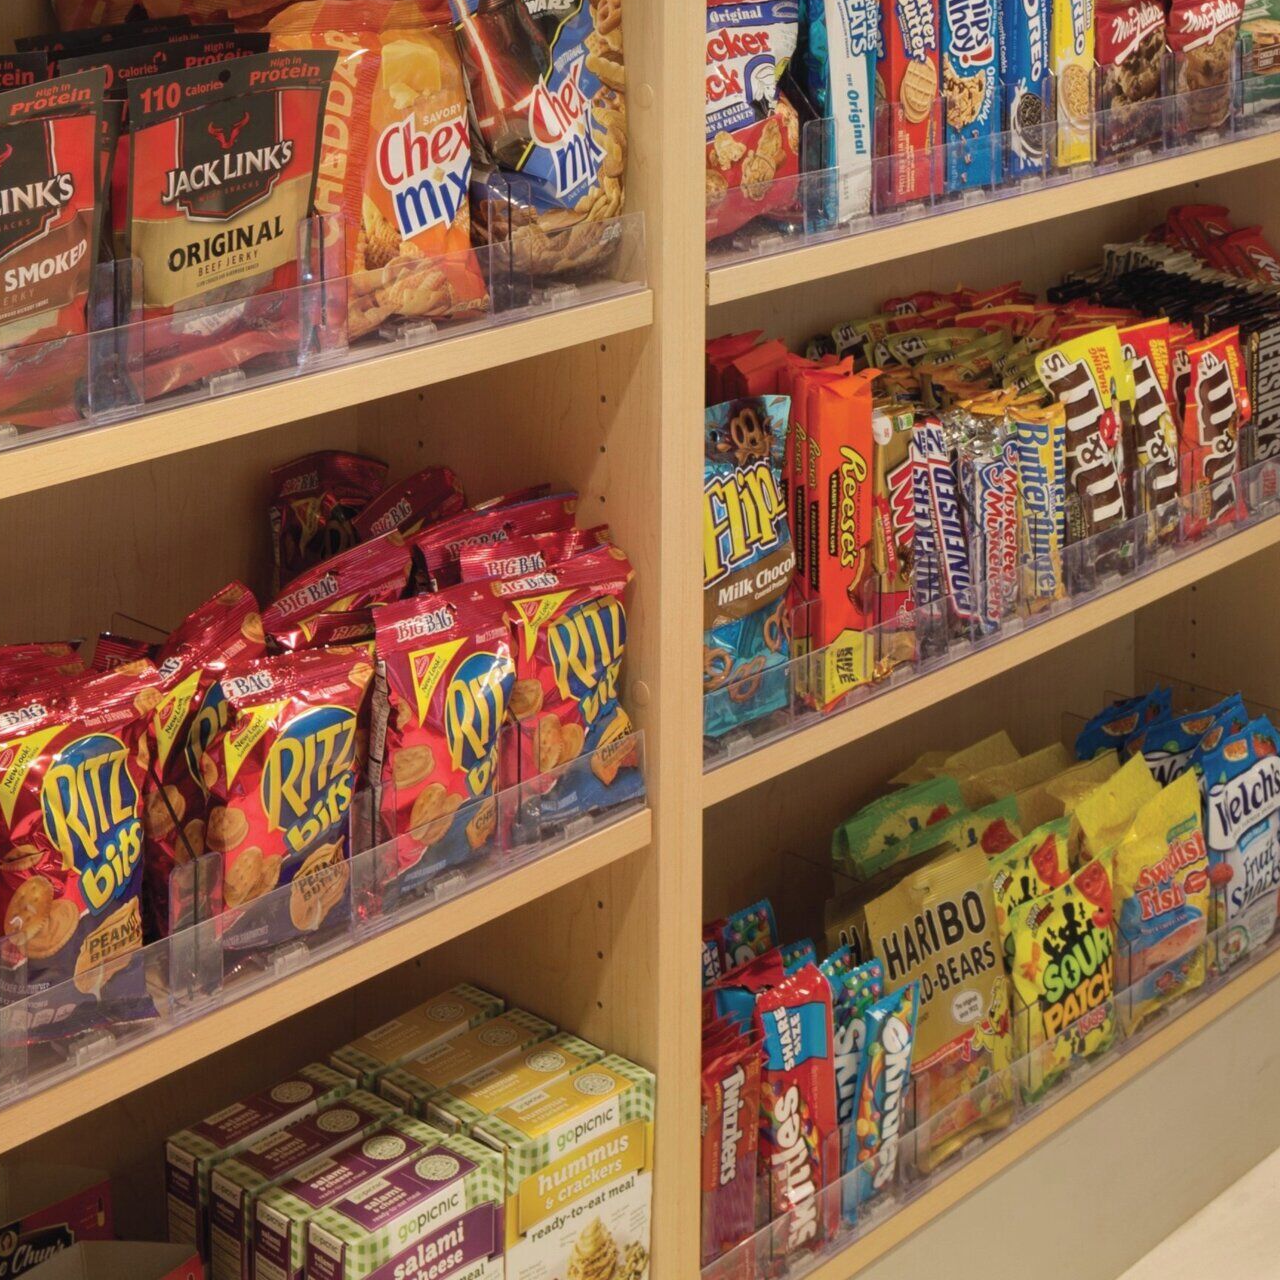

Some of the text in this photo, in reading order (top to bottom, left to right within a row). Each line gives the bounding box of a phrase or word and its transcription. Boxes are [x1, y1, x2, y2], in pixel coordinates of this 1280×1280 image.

[710, 5, 762, 24] Original
[9, 88, 91, 117] Protein
[141, 81, 225, 114] 110 Calories
[249, 65, 320, 87] Protein
[979, 65, 995, 126] ORIGINAL
[313, 28, 363, 248] CHEDDAR
[422, 103, 462, 126] SAVORY
[846, 89, 867, 155] Original
[162, 140, 293, 204] JACK LINK'S
[378, 116, 470, 186] Chex
[4, 239, 88, 293] SMOKED
[167, 216, 284, 273] ORIGINAL
[198, 250, 258, 277] BEEF JERKY
[1088, 348, 1110, 395] SHARING
[1098, 347, 1111, 371] SIZE
[840, 445, 868, 568] Reese's
[986, 489, 1003, 619] Musketeers
[308, 576, 339, 603] BAG
[718, 577, 754, 606] Milk
[397, 609, 453, 643] BIG BAG
[267, 719, 357, 835] RITZ
[44, 747, 140, 872] RITZ
[285, 771, 354, 854] bits
[79, 818, 141, 914] bits
[1243, 840, 1275, 887] Fruit
[1138, 887, 1184, 920] Fish
[88, 912, 140, 953] PEANUT
[882, 891, 986, 980] HARIBO
[1043, 926, 1111, 1003] SOUR
[1044, 956, 1113, 1039] PATCH
[773, 1006, 789, 1072] SHARE
[790, 1012, 801, 1056] SIZE
[557, 1108, 614, 1151] gopicnic
[720, 1064, 745, 1186] Twizzlers
[538, 1135, 629, 1196] hummus
[558, 1158, 622, 1201] crackers
[772, 1085, 817, 1253] Skittles
[397, 1192, 460, 1243] gopicnic
[531, 1176, 635, 1243] ready-to-eat meal
[393, 1220, 465, 1278] salami
